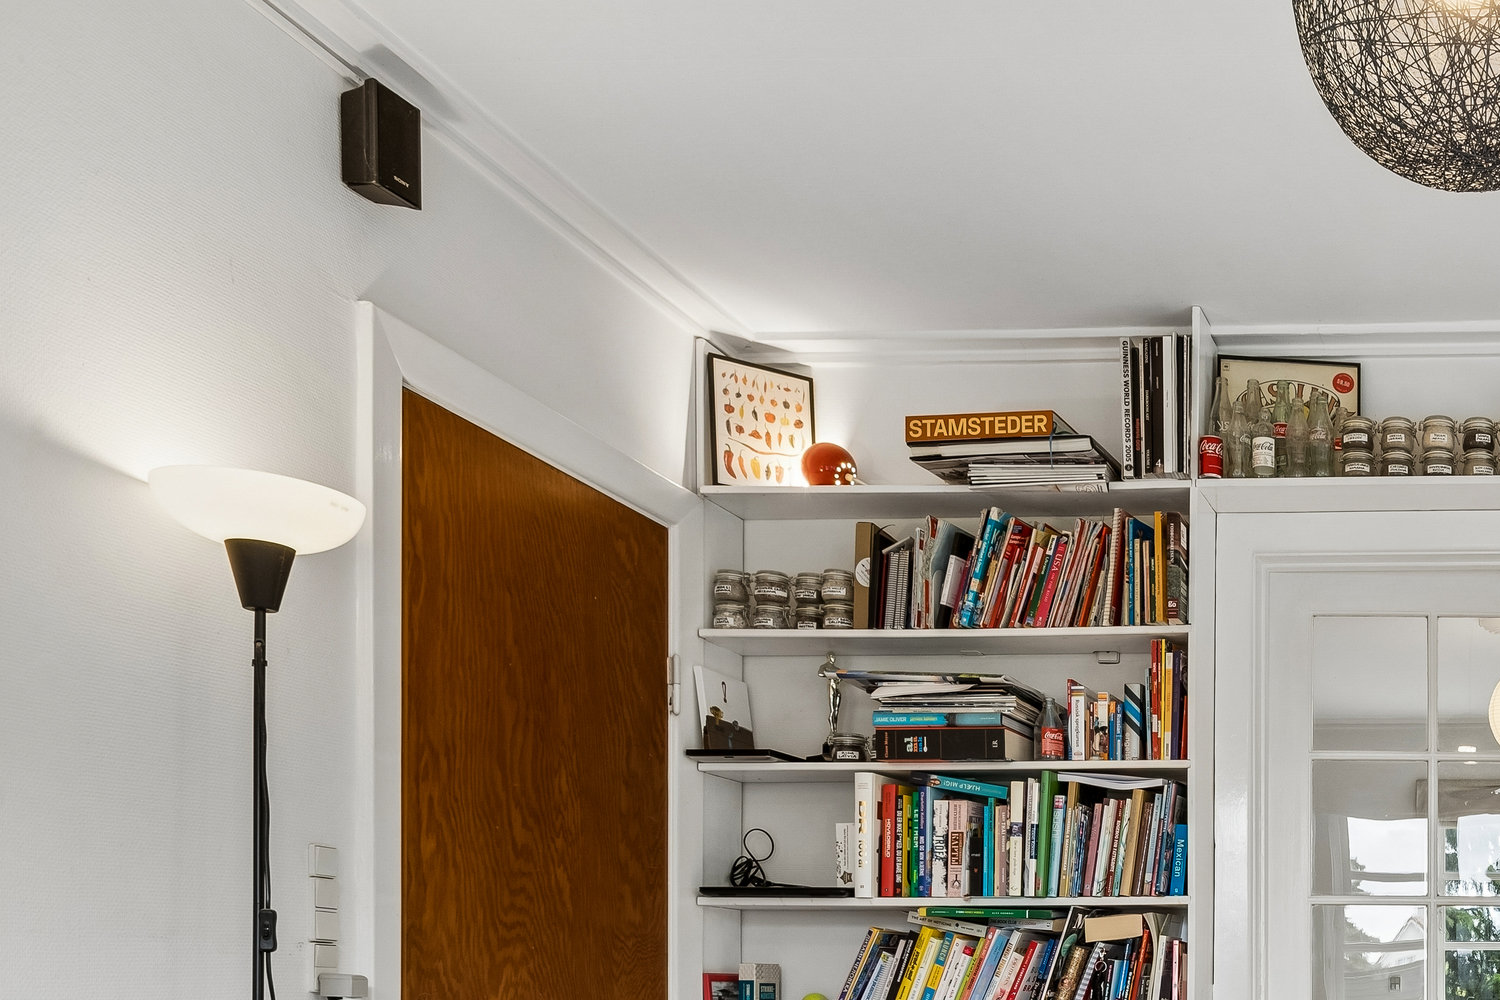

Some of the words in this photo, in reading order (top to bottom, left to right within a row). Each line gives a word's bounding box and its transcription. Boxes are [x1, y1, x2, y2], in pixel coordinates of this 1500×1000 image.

[909, 415, 1047, 438] STAMSTEDER
[1051, 553, 1063, 572] USA
[904, 736, 913, 752] al
[1044, 732, 1063, 741] Coca-Cola
[943, 780, 957, 788] MIG!
[958, 783, 981, 791] HJÆLP
[934, 835, 945, 862] TROFÆ
[951, 833, 959, 865] КАРТЫ
[1174, 839, 1185, 877] Mexican
[934, 919, 952, 927] NOTICING
[939, 936, 952, 962] LAUNCH
